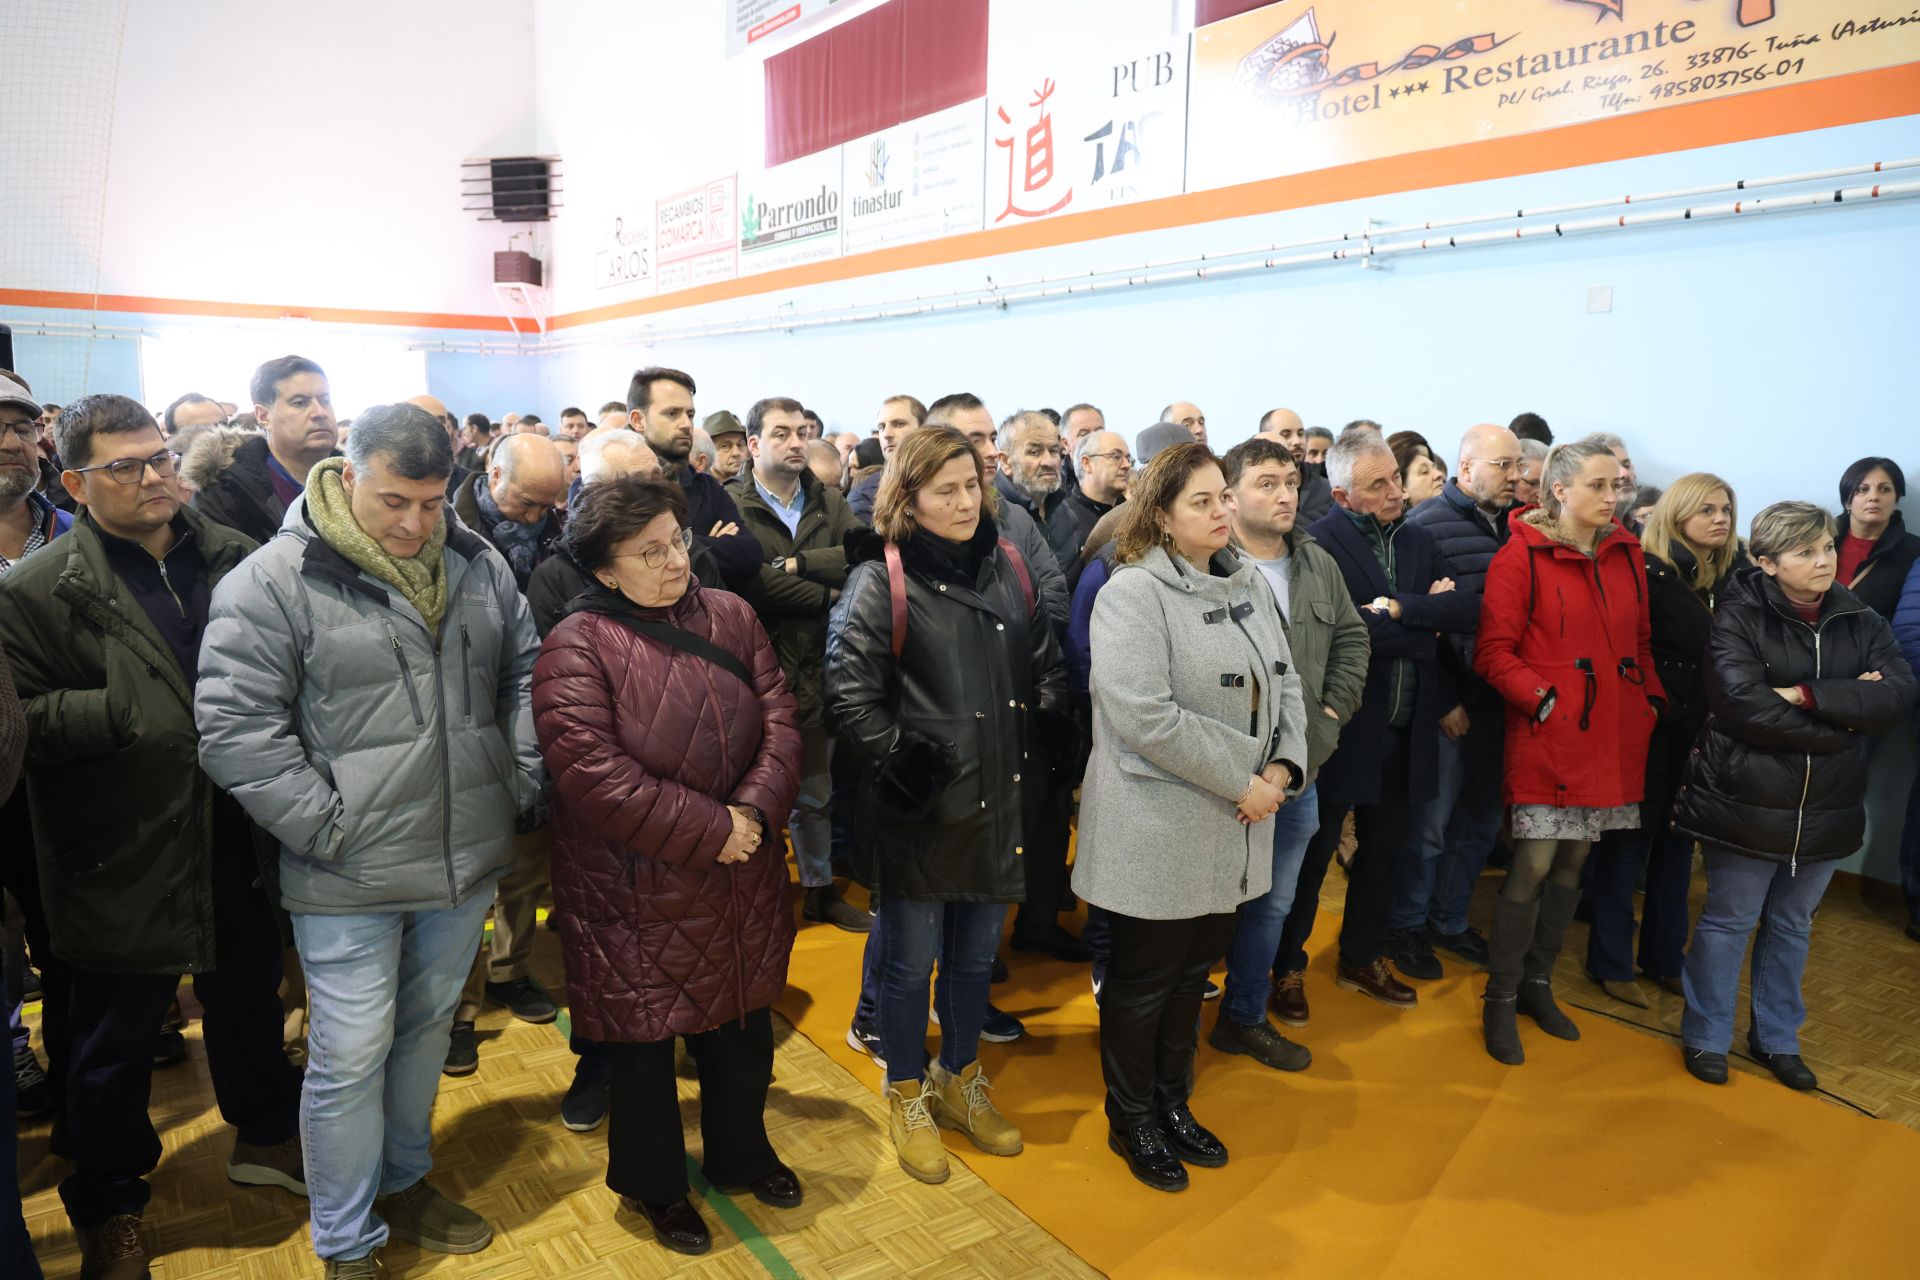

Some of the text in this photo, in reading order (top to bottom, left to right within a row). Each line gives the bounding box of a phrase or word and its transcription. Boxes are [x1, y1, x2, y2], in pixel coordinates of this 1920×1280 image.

[1111, 51, 1173, 98] PUB
[1296, 19, 1697, 124] Hotel Restaurante
[1640, 60, 1669, 80] 26.
[1765, 34, 1821, 53] Tuña
[1650, 57, 1805, 101] 985803756-01
[660, 196, 705, 225] RECAMBIOS
[757, 184, 839, 231] Parrondo
[852, 189, 904, 218] tinastur
[660, 219, 705, 250] COMARCA
